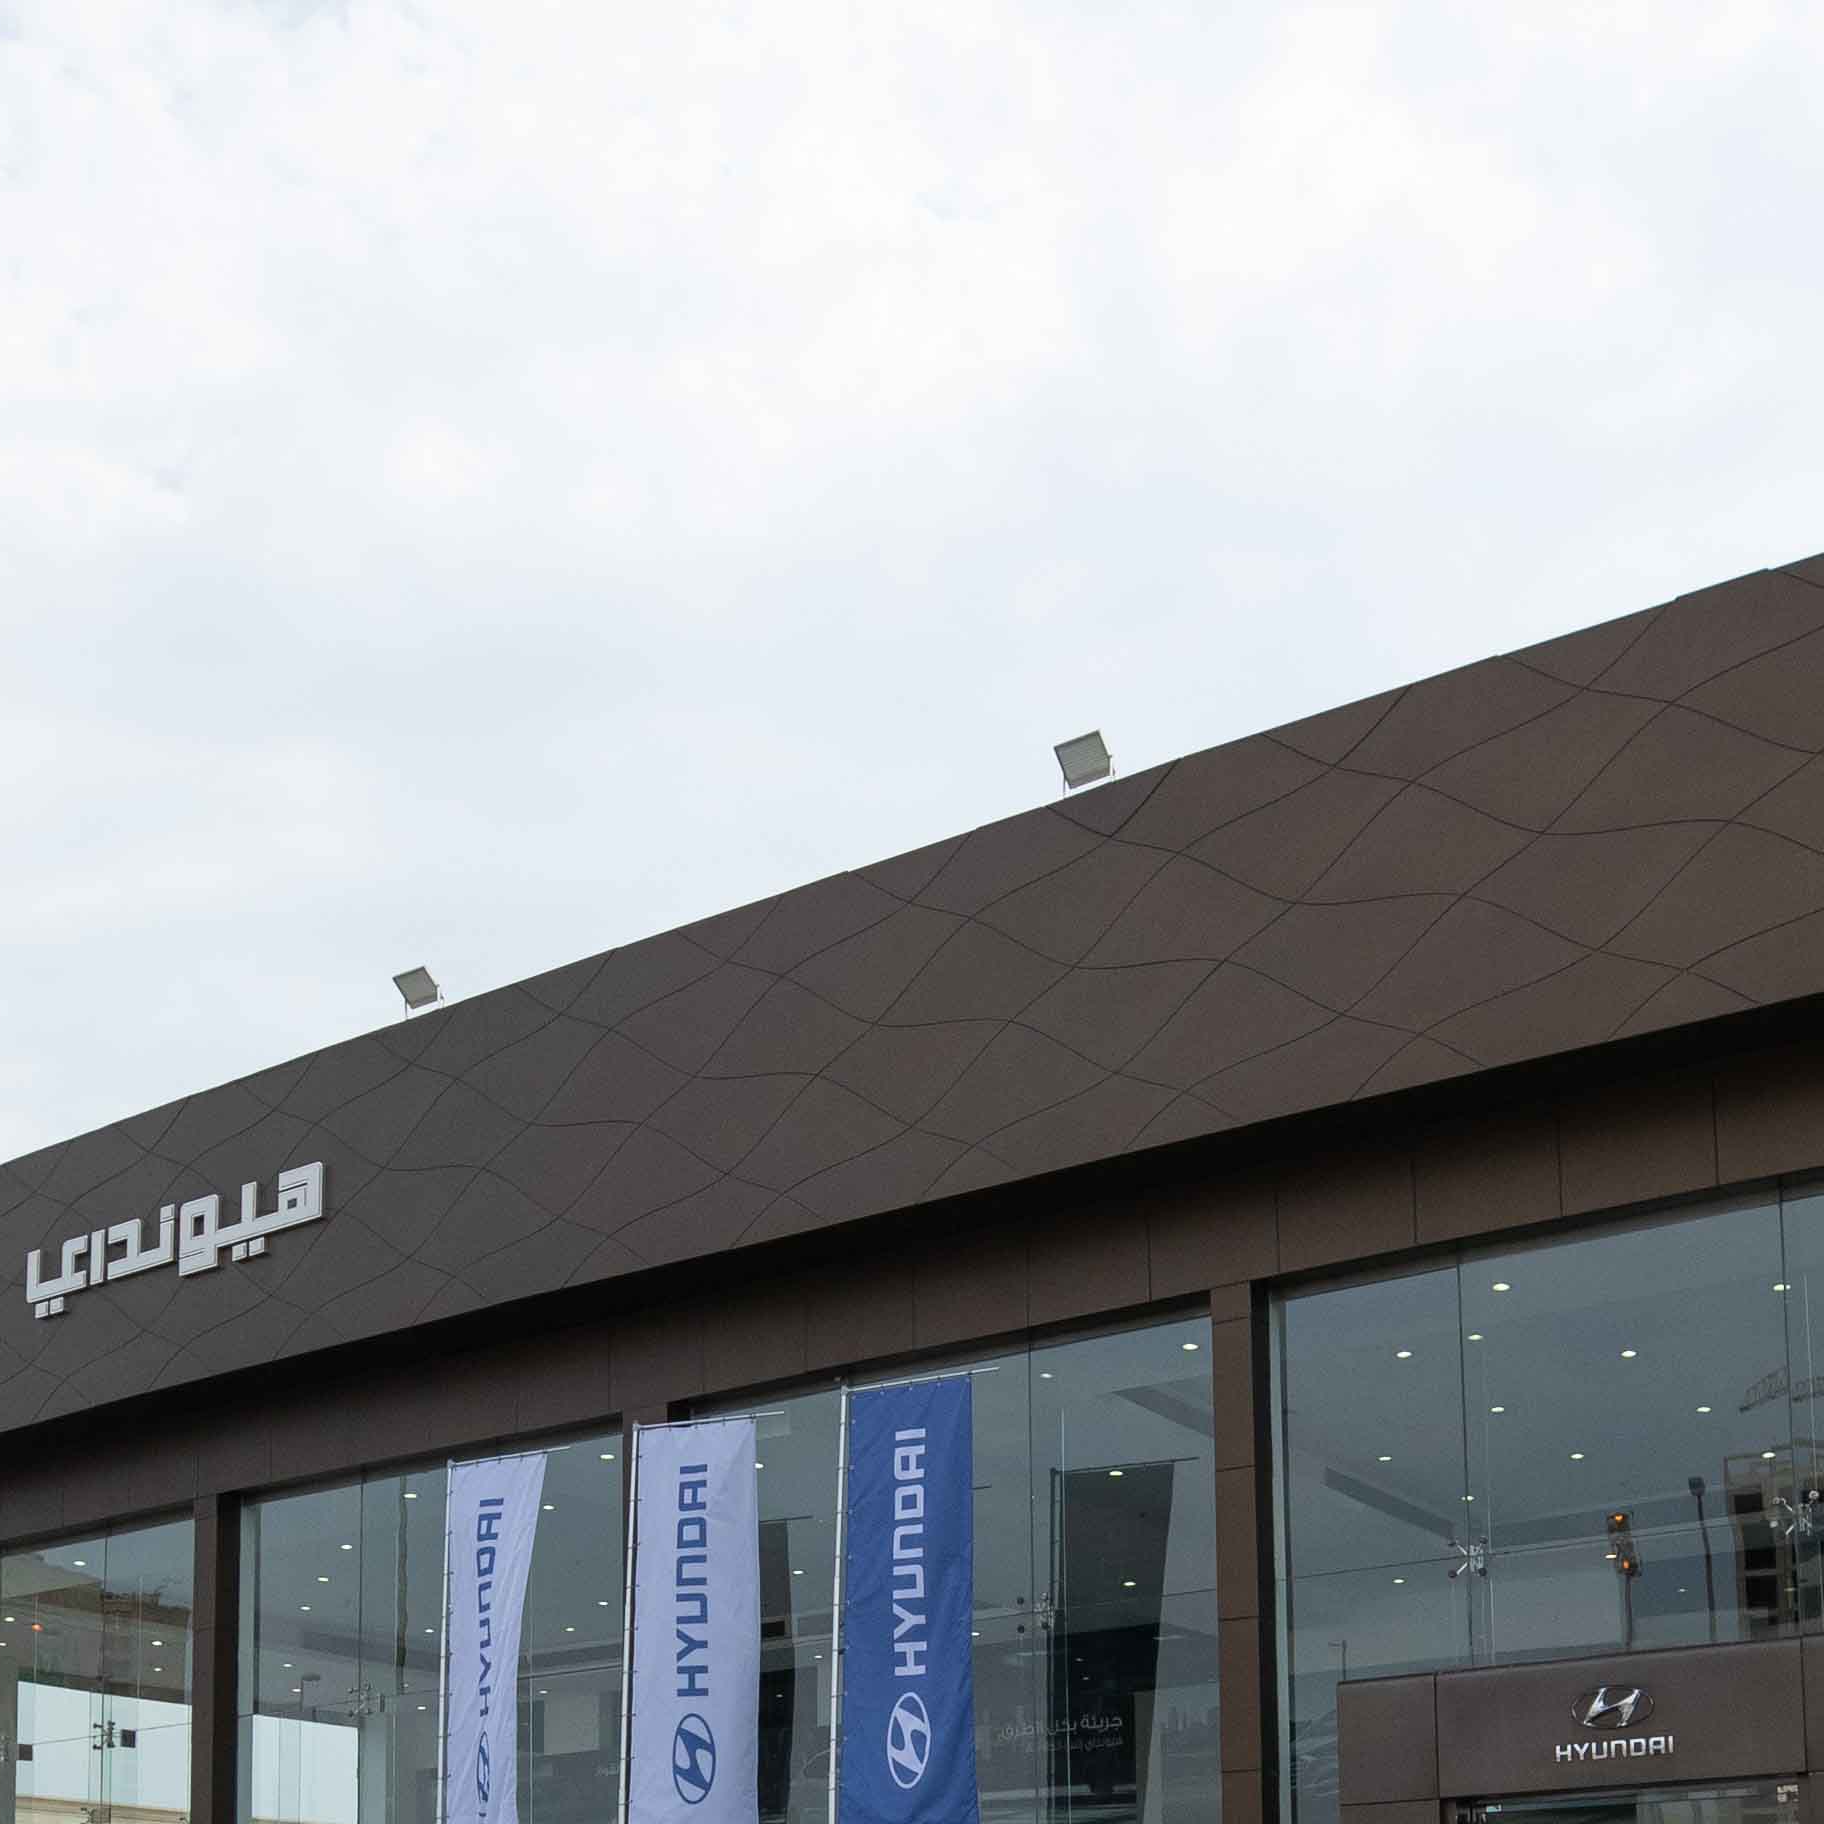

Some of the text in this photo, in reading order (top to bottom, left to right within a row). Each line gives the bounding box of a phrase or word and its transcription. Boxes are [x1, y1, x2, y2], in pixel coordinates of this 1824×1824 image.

[25, 1160, 325, 1320] هيونداي
[478, 1497, 505, 1715] HYUNDAI
[675, 1462, 709, 1698] HYUNDAI
[892, 1427, 927, 1677] HYUNDAI
[1555, 1734, 1675, 1763] HYUNDAI
